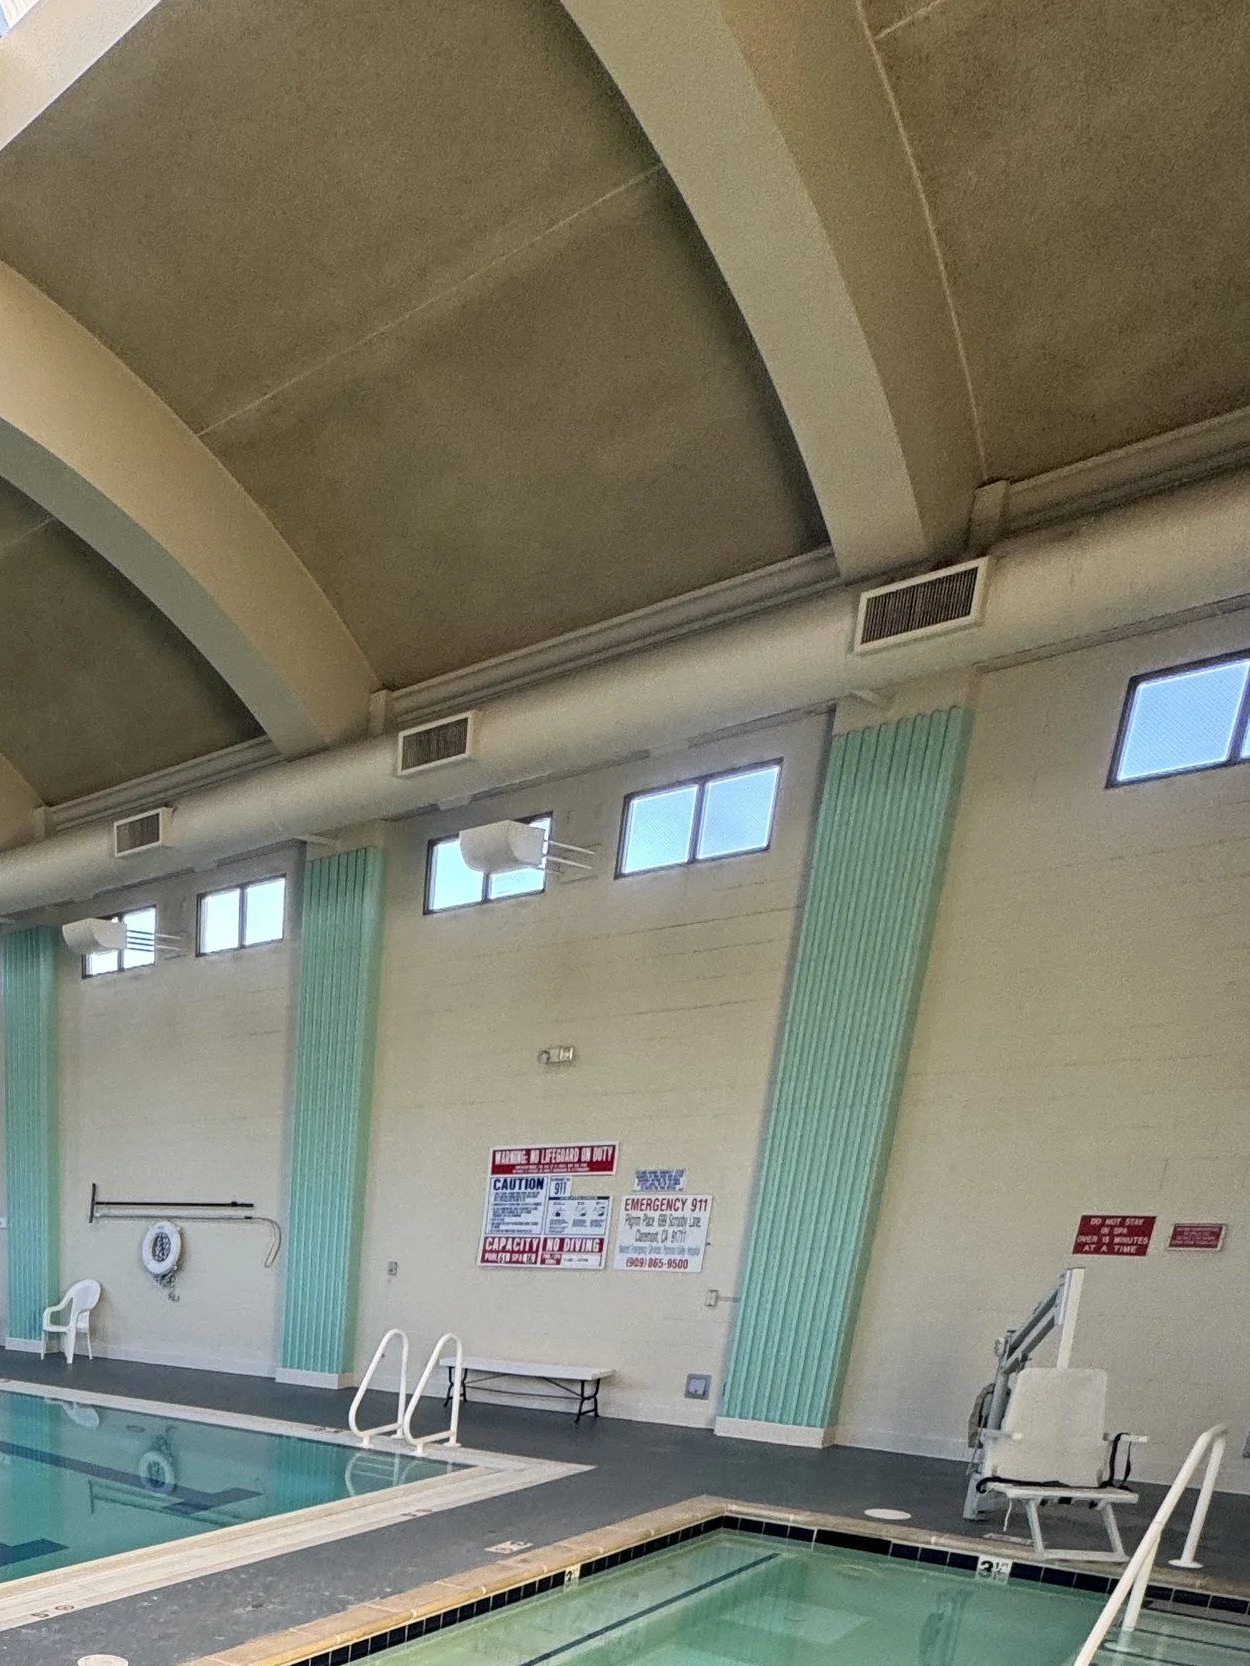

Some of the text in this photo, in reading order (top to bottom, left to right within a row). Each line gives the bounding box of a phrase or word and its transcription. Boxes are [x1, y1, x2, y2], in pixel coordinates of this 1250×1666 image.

[541, 1147, 580, 1164] LIFEGUARD
[580, 1147, 592, 1162] ON
[592, 1145, 614, 1161] DUTY
[493, 1178, 544, 1191] CAUTION
[554, 1182, 567, 1195] 911
[624, 1198, 708, 1212] EMERGENCY 911
[1090, 1217, 1145, 1226] DO NOT STAY
[485, 1237, 539, 1252] CAPACITY
[546, 1238, 600, 1252] NO DIVING
[1113, 1236, 1149, 1245] MINUTES
[1113, 1245, 1138, 1253] TIME
